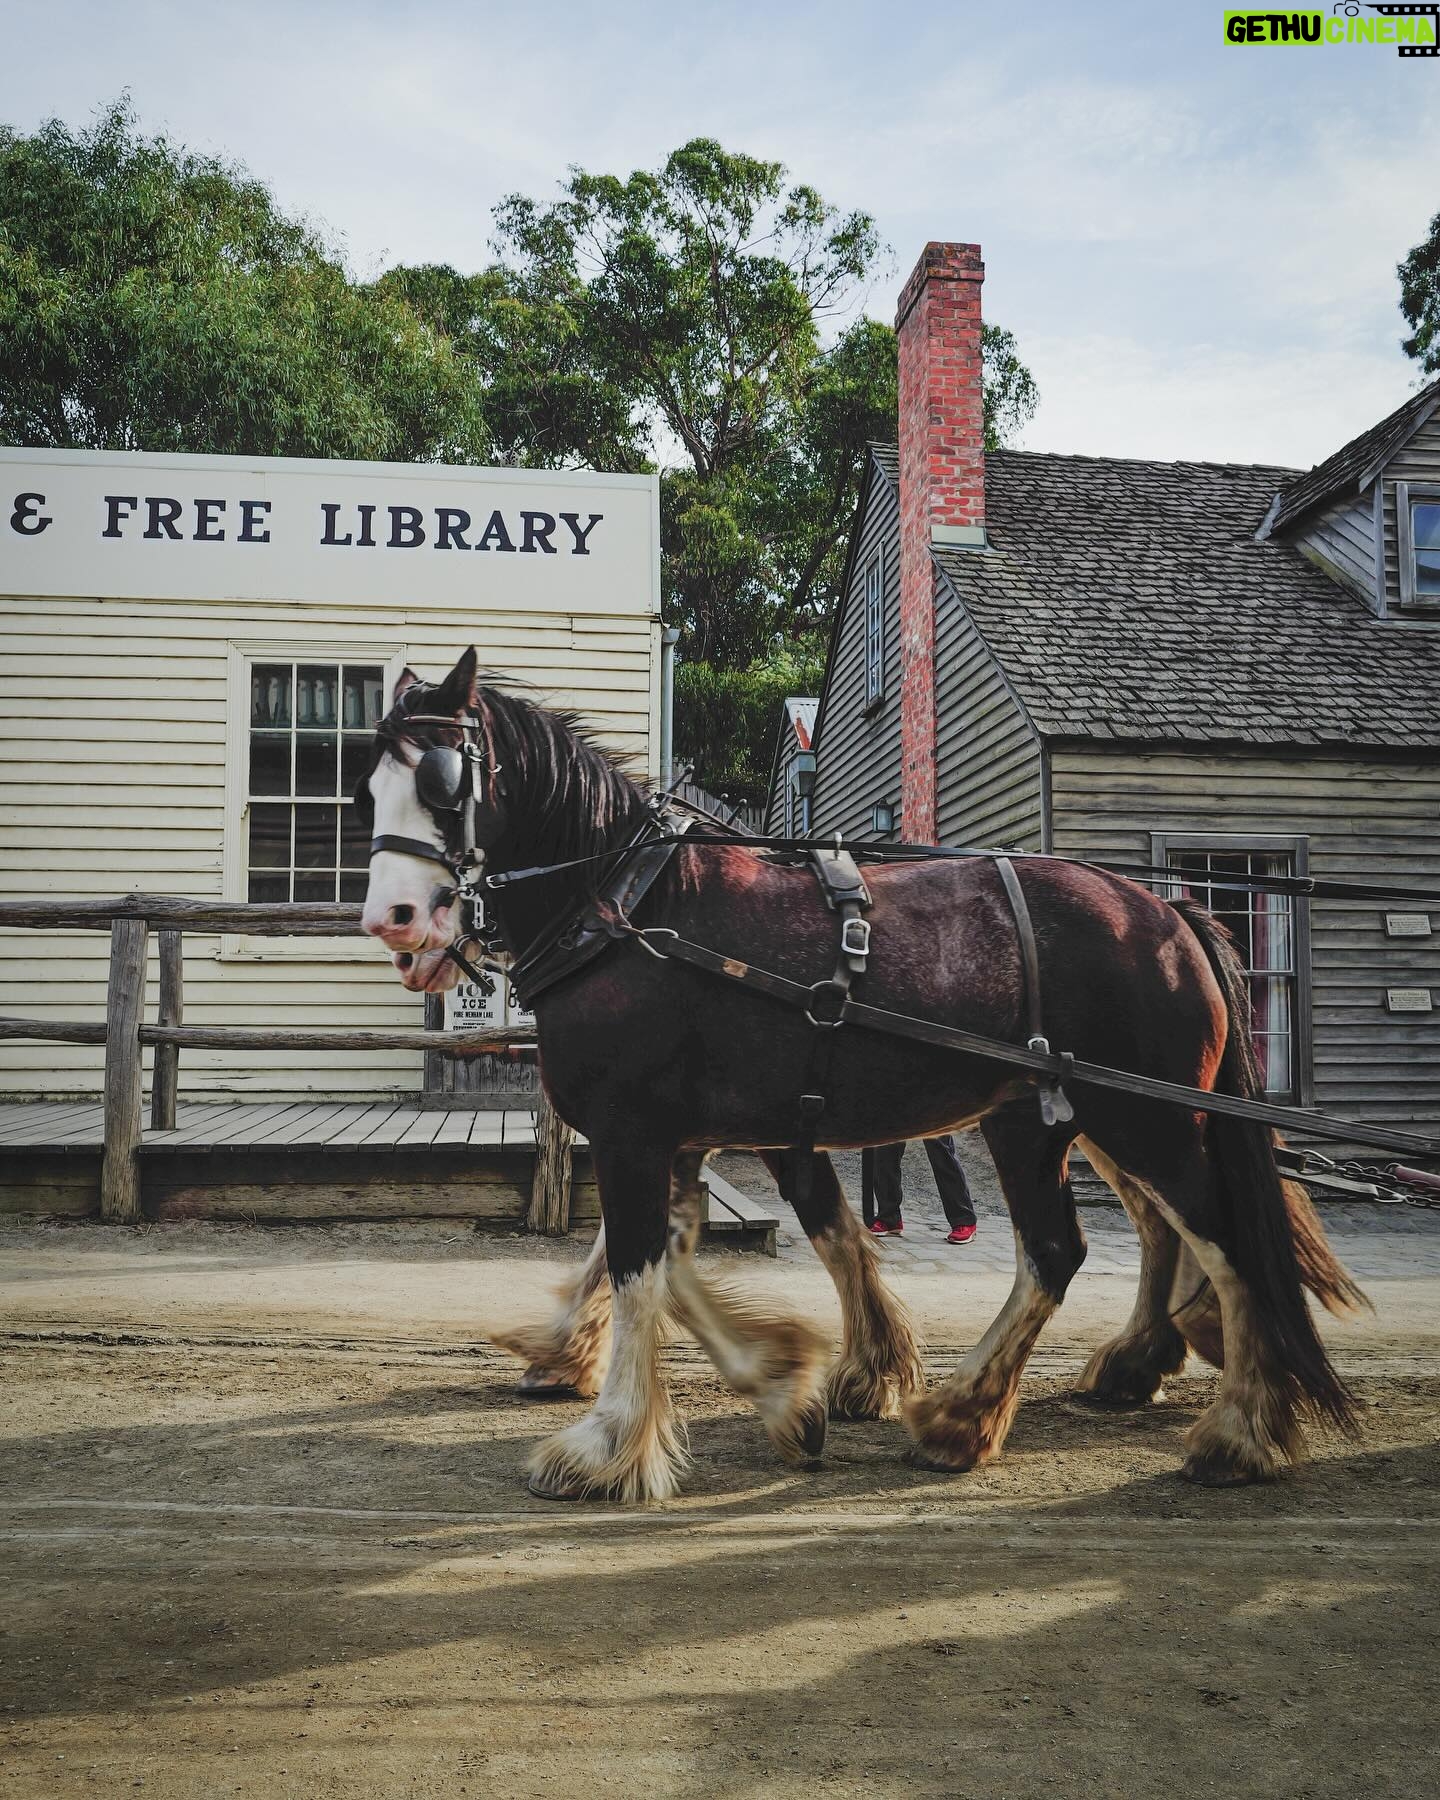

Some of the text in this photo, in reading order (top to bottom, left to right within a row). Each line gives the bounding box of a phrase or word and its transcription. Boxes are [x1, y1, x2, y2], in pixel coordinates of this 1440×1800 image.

[10, 493, 604, 554] & FREE LIBRARY
[462, 999, 487, 1009] ICE
